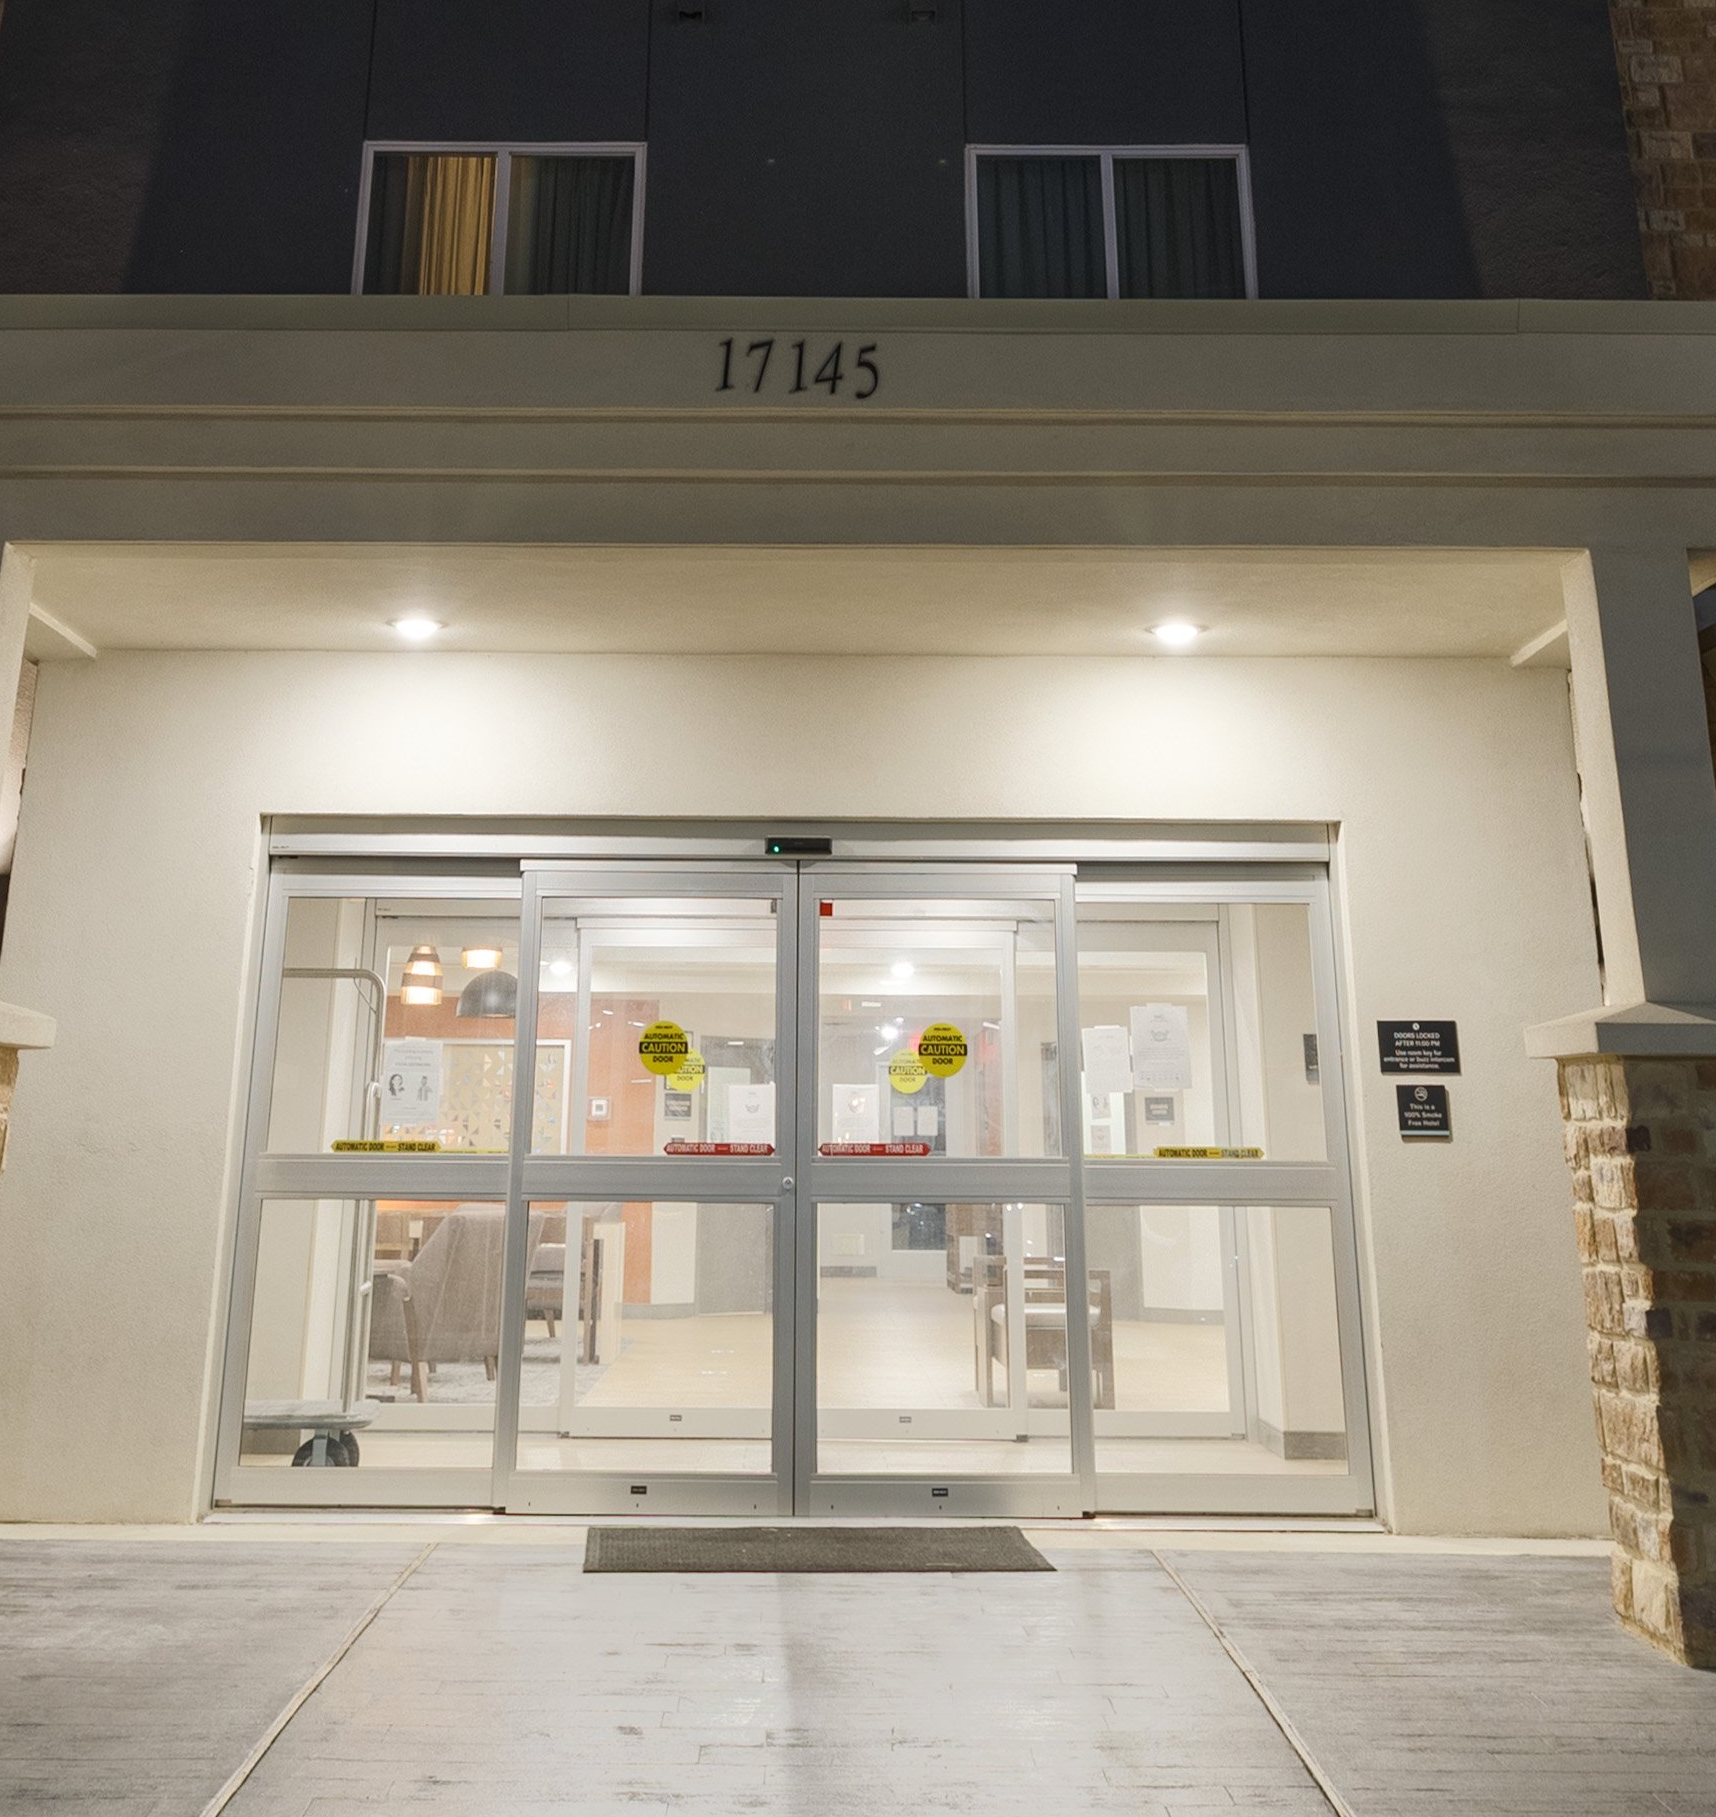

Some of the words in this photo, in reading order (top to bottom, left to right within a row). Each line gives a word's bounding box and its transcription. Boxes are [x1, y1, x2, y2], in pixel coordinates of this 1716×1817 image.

[715, 337, 879, 400] 17145
[641, 1043, 686, 1053] CAUTION
[920, 1045, 965, 1055] CAUTION
[890, 1066, 924, 1075] CAUTION
[335, 1141, 368, 1152] AUTOMATIC
[369, 1141, 384, 1152] DOOR
[398, 1141, 416, 1152] STAND
[417, 1141, 436, 1152] CLEAR
[666, 1144, 699, 1153] AUTOMATIC
[699, 1144, 715, 1153] DOOR
[730, 1144, 748, 1153] STAND
[750, 1144, 768, 1153] CLEAR
[822, 1144, 854, 1153] AUTOMATIC
[854, 1144, 870, 1153] DOOR
[885, 1144, 904, 1153] STAND
[905, 1144, 924, 1153] CLEAR
[1158, 1149, 1190, 1158] AUTOMATIC
[1192, 1149, 1207, 1158] DOOR
[1221, 1149, 1239, 1158] STAND
[1241, 1149, 1259, 1158] CLEAR
